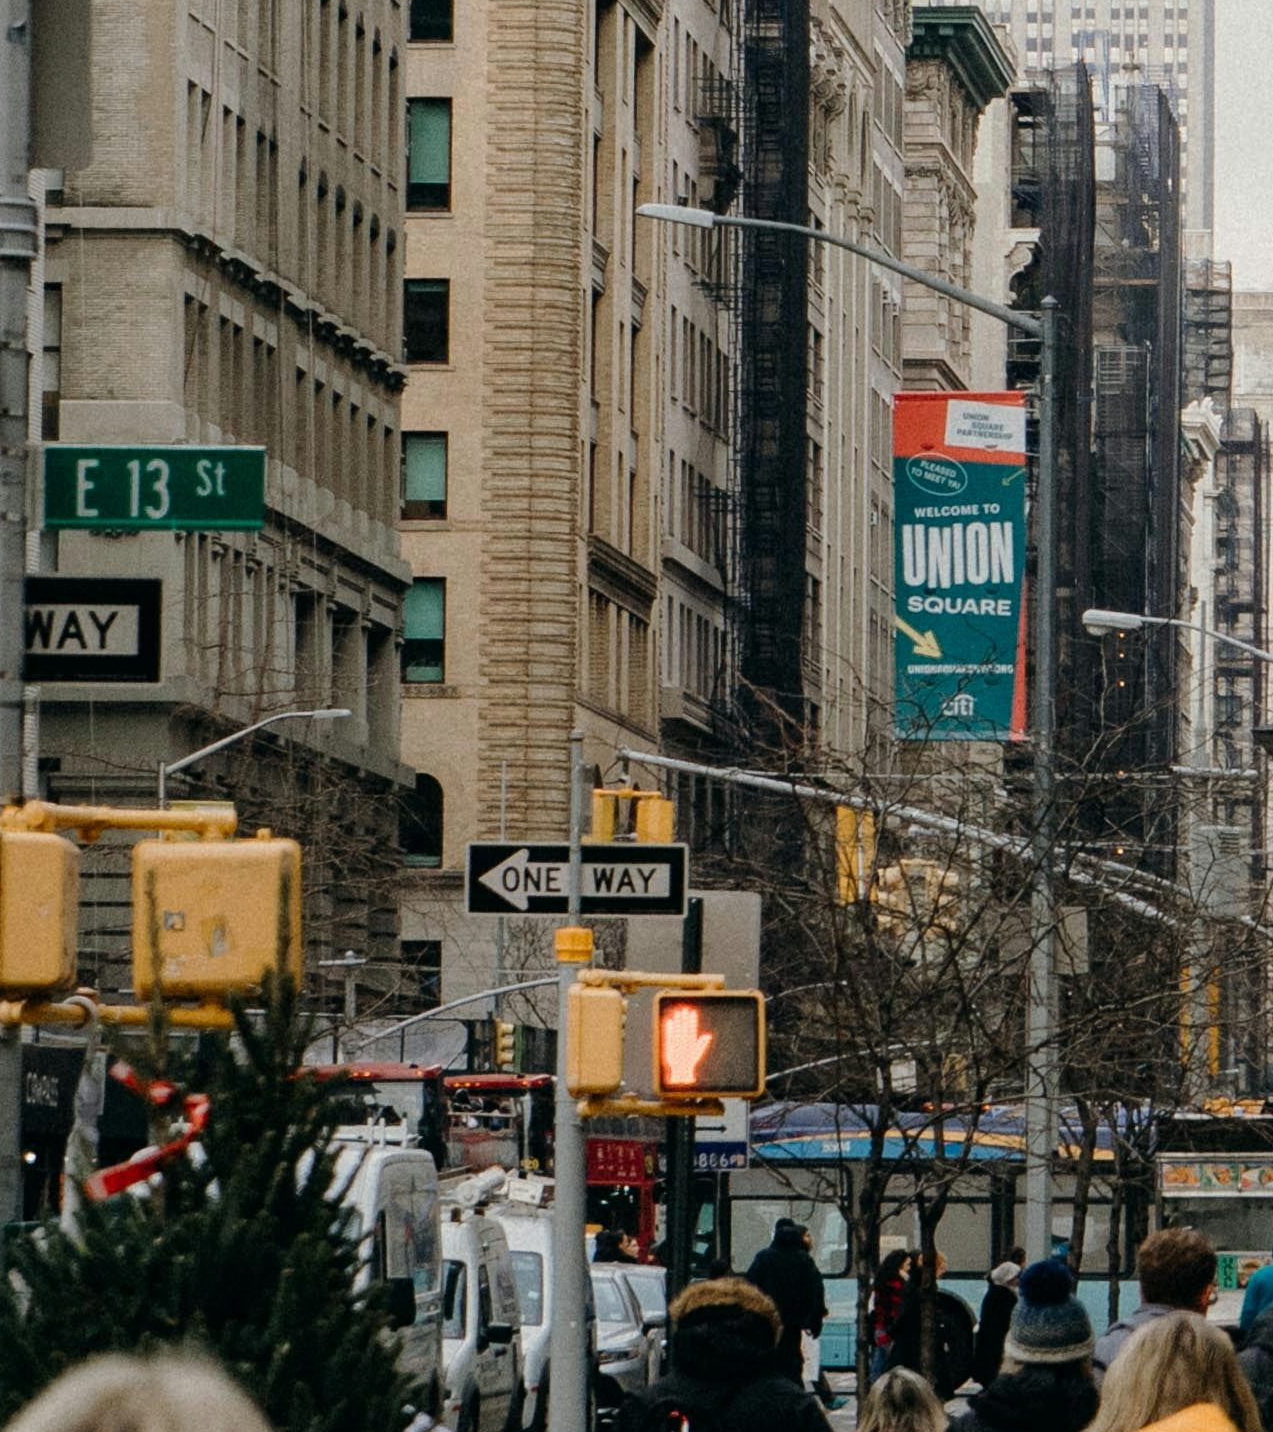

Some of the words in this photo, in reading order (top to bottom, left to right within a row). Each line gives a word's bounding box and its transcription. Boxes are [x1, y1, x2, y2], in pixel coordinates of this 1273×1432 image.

[76, 458, 99, 517] E
[126, 458, 170, 519] 13
[196, 459, 226, 496] St
[913, 504, 980, 519] WELCOME
[982, 502, 1001, 515] TO
[901, 521, 1015, 589] UNION
[906, 595, 1013, 617] SQUARE
[25, 609, 119, 650] WAY
[501, 866, 561, 893] ONE
[592, 868, 657, 894] WAY
